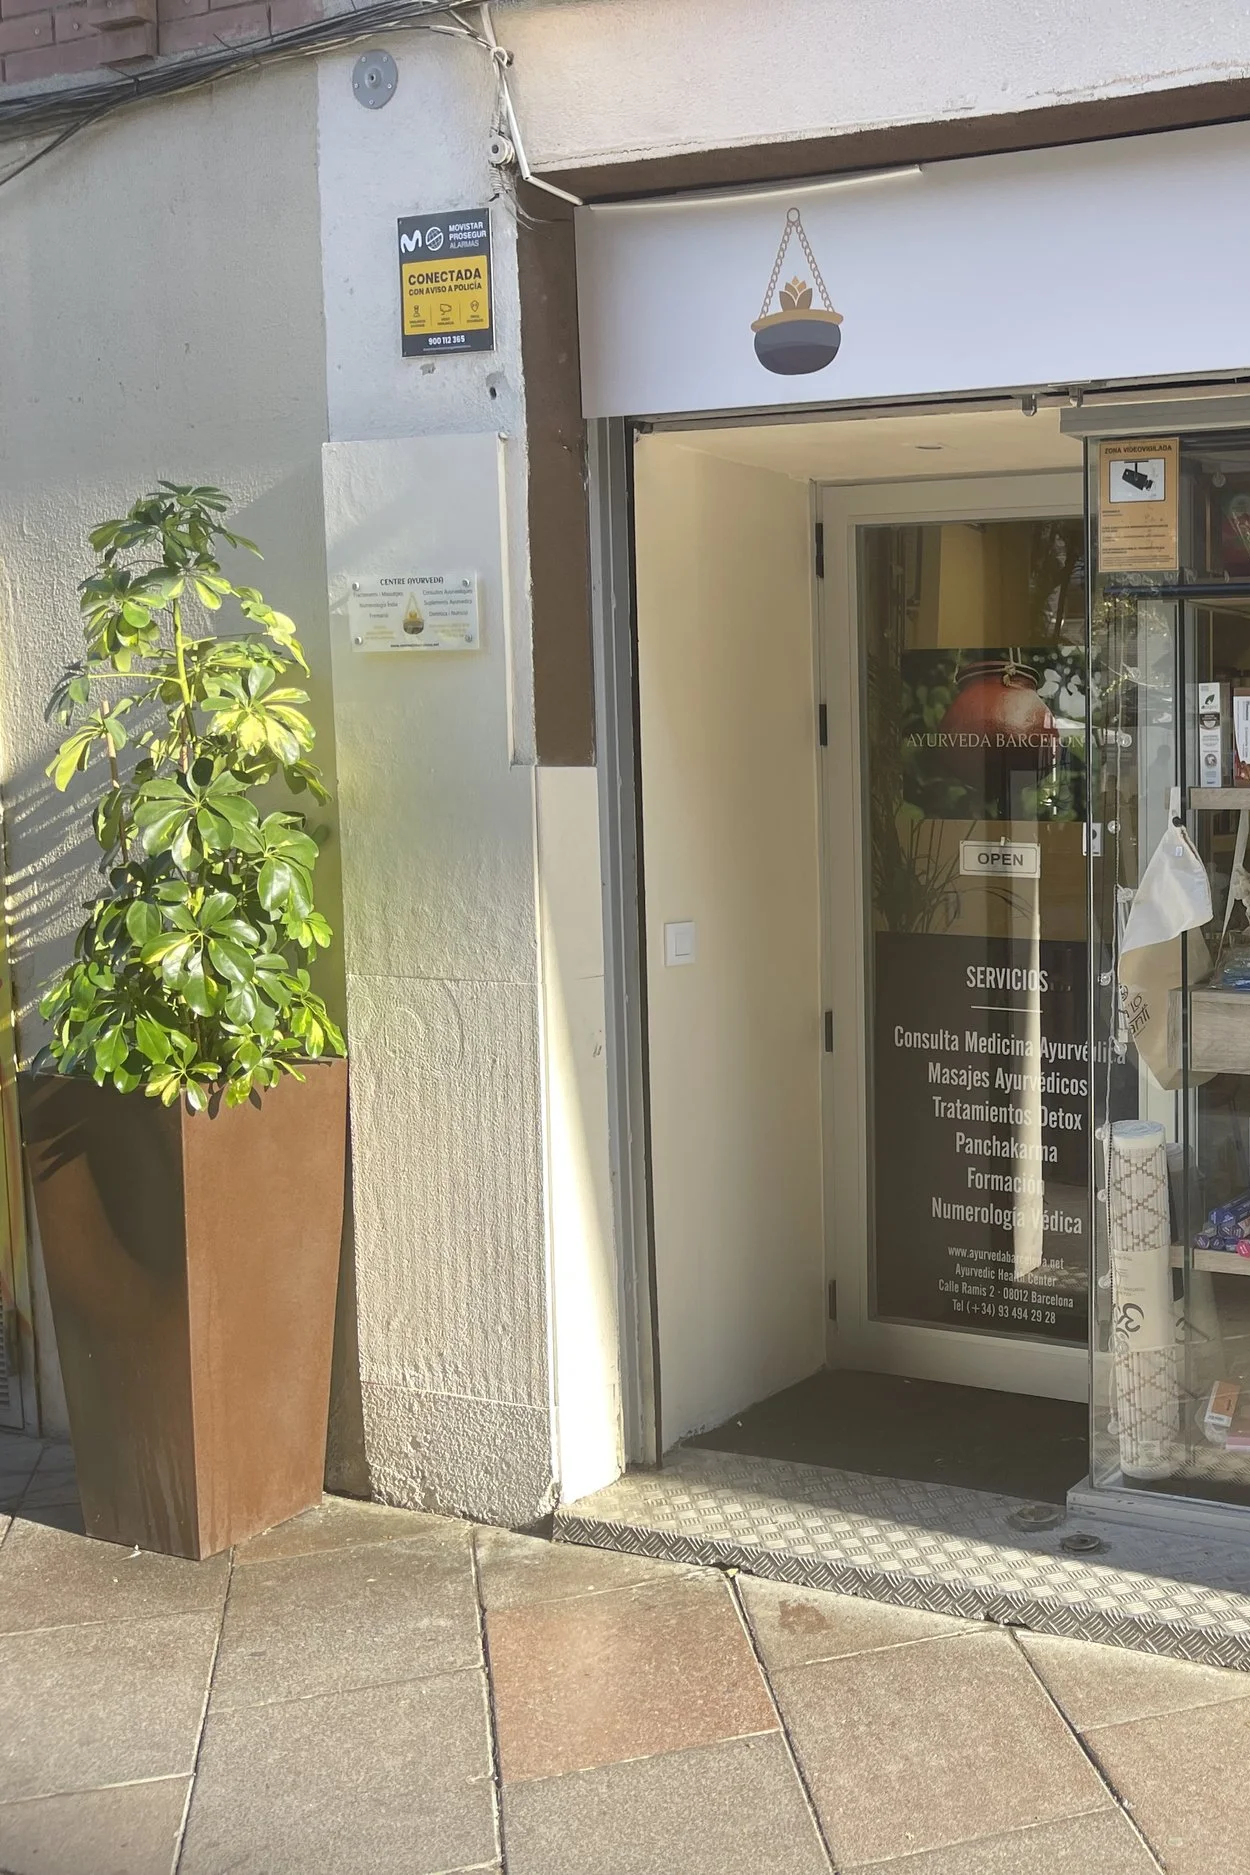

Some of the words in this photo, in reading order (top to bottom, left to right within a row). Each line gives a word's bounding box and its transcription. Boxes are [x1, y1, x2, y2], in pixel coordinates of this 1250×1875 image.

[448, 221, 484, 233] MOVISTAR
[448, 229, 487, 241] PROSEGUR
[449, 239, 480, 249] ALARMAS
[408, 267, 482, 286] CONECTADA
[408, 288, 425, 296] CON
[425, 285, 447, 295] AVISO
[447, 284, 453, 292] A
[453, 281, 482, 292] POLICÍA
[428, 336, 442, 346] 900
[442, 335, 452, 344] 112
[452, 334, 466, 344] 365
[1104, 447, 1122, 455] ZONA
[1123, 444, 1173, 453] VIDEOVIGILADA
[379, 577, 405, 586] CENTRE
[407, 576, 444, 585] AYURVEDA
[906, 733, 992, 748] AYURVEDA
[977, 852, 1024, 867] OPEN
[966, 965, 1049, 993] SERVICIOS
[894, 1025, 959, 1052] Consulta
[965, 1030, 1034, 1057] Medicina
[928, 1062, 990, 1091] Masajes
[994, 1067, 1088, 1097] Ayurvédicos
[932, 1095, 1033, 1126] Tratamientos
[1040, 1105, 1083, 1131] Detox
[955, 1132, 1058, 1163] Panchakarma
[967, 1167, 1046, 1196] Formación
[931, 1196, 1025, 1231] Numerología
[1030, 1206, 1082, 1235] Védica
[955, 1263, 996, 1280] Ayurvedic
[1027, 1272, 1057, 1288] Center
[938, 1278, 960, 1293] Calle
[961, 1281, 987, 1298] Ramis
[989, 1285, 996, 1299] 2
[1003, 1287, 1029, 1302] 08012
[1031, 1290, 1074, 1309] Barcelona
[952, 1299, 964, 1312] Tel
[998, 1304, 1010, 1318] 93
[1011, 1306, 1029, 1321] 494
[1030, 1309, 1042, 1323] 29
[1044, 1311, 1056, 1325] 28
